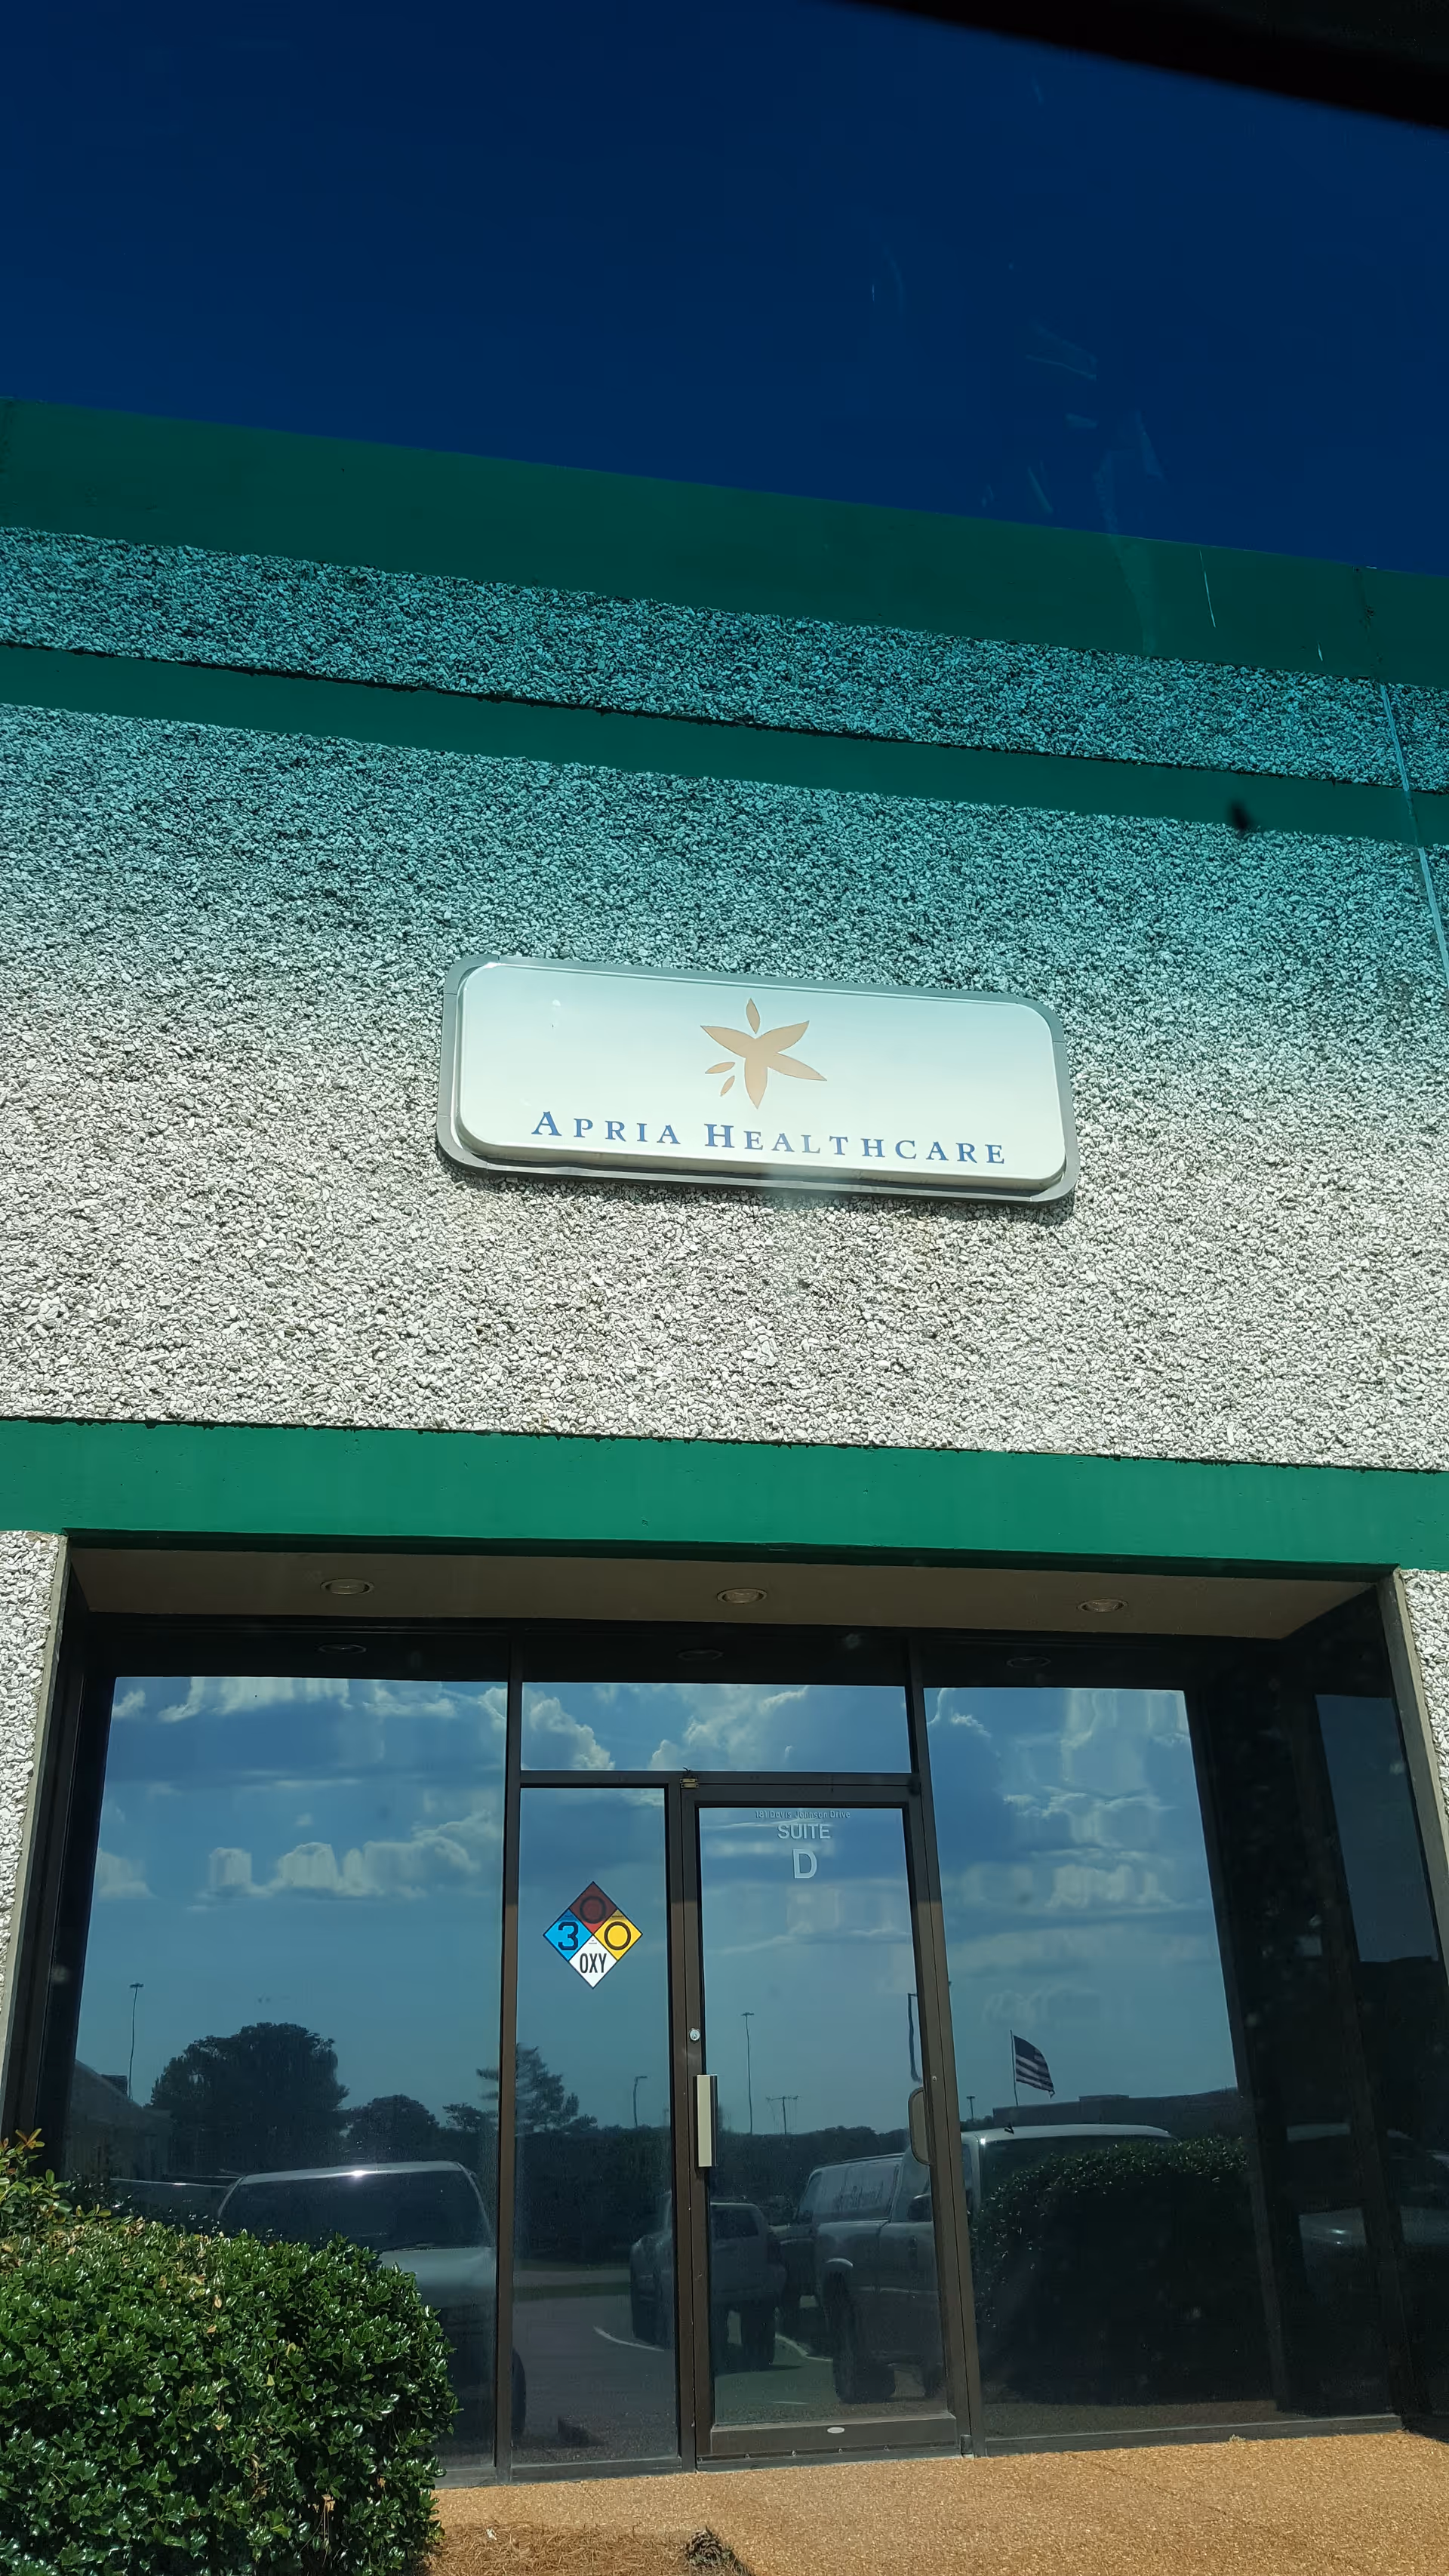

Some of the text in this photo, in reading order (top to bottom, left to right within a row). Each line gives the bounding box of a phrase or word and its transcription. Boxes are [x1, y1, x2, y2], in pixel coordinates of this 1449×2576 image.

[531, 1111, 1005, 1164] APRIA HEALTHCARE
[770, 1811, 792, 1819] Davis
[795, 1811, 828, 1819] Johnson
[829, 1811, 851, 1819] Drive
[777, 1824, 832, 1839] SUITE
[792, 1848, 817, 1879] D
[558, 1921, 579, 1951] 3
[580, 1953, 607, 1974] OXY
